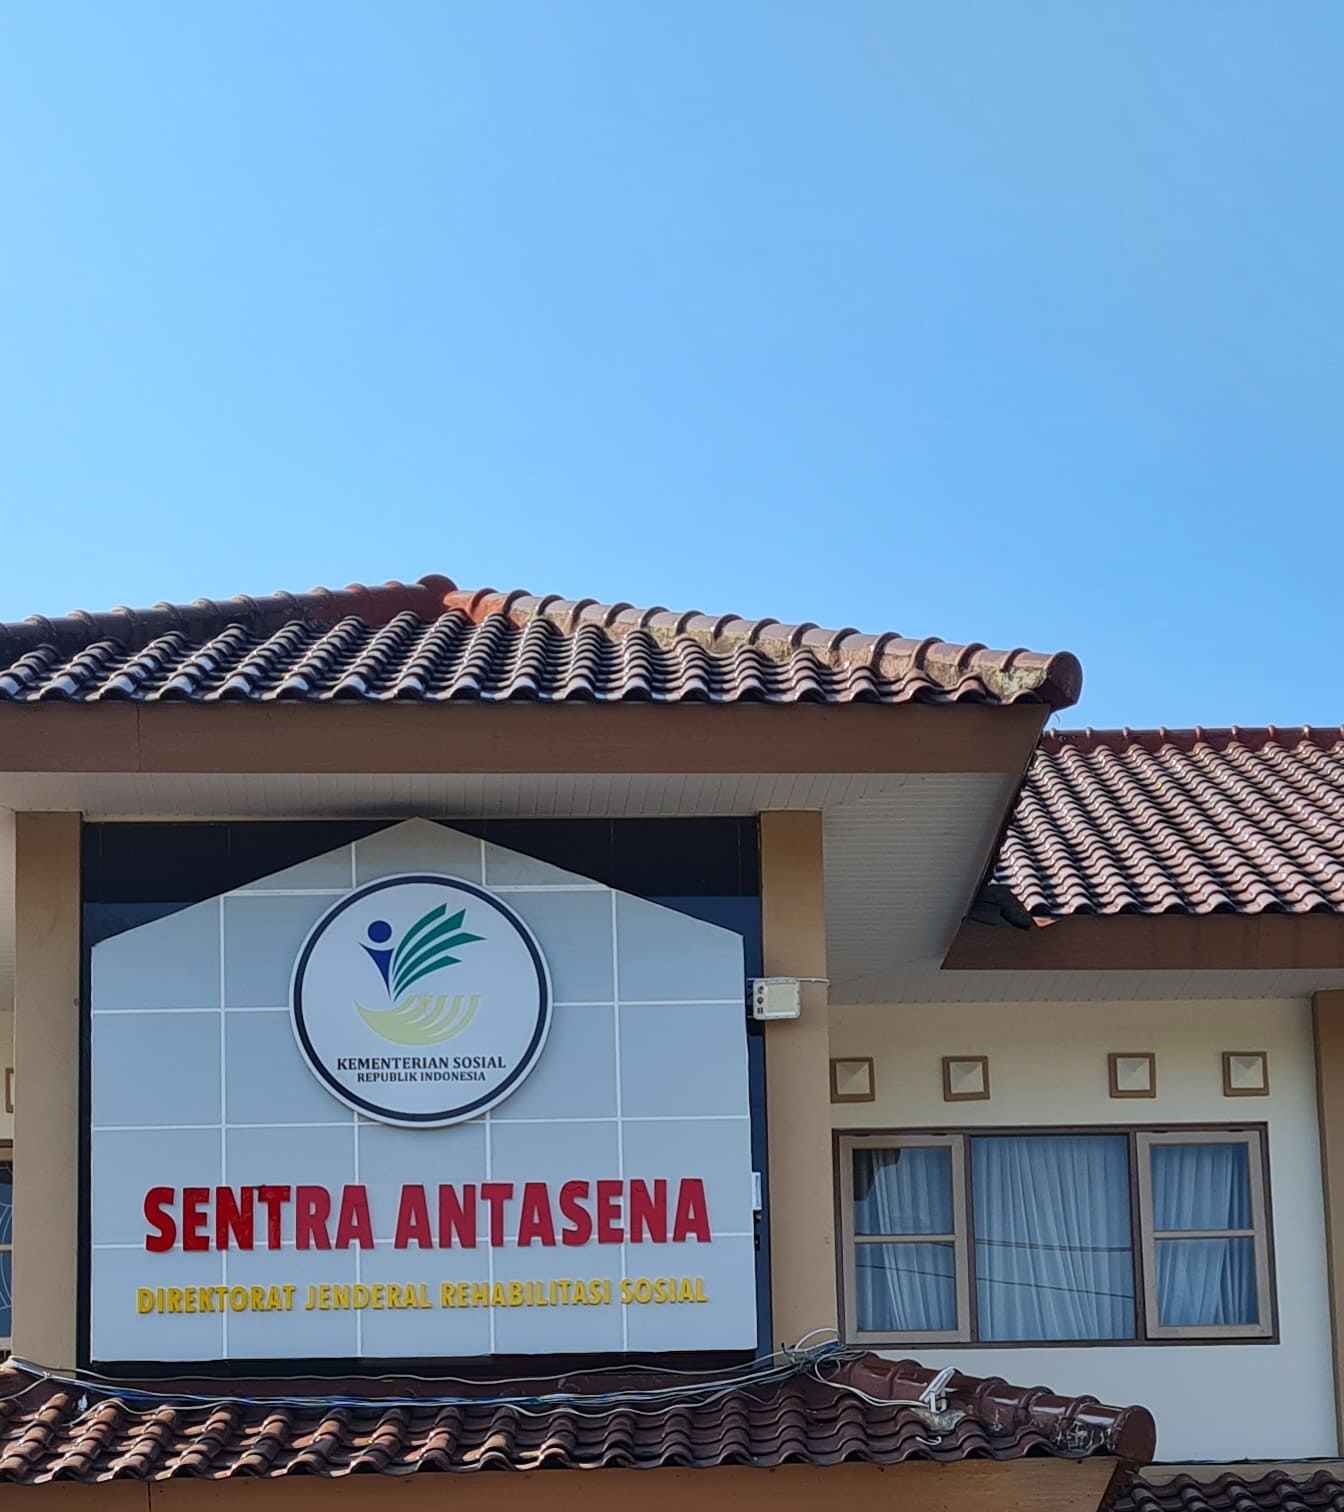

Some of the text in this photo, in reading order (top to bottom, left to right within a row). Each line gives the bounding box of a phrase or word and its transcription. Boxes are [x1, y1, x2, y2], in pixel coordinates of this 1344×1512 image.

[337, 1056, 506, 1070] KEMENTERIAN SOSIAL
[357, 1071, 486, 1083] REPUBLIK INDONESIA
[144, 1178, 712, 1252] SENTRA ANTASENA
[137, 1276, 709, 1314] DIREKTORAT JENDERAL REHABILITASI SOSIAL
